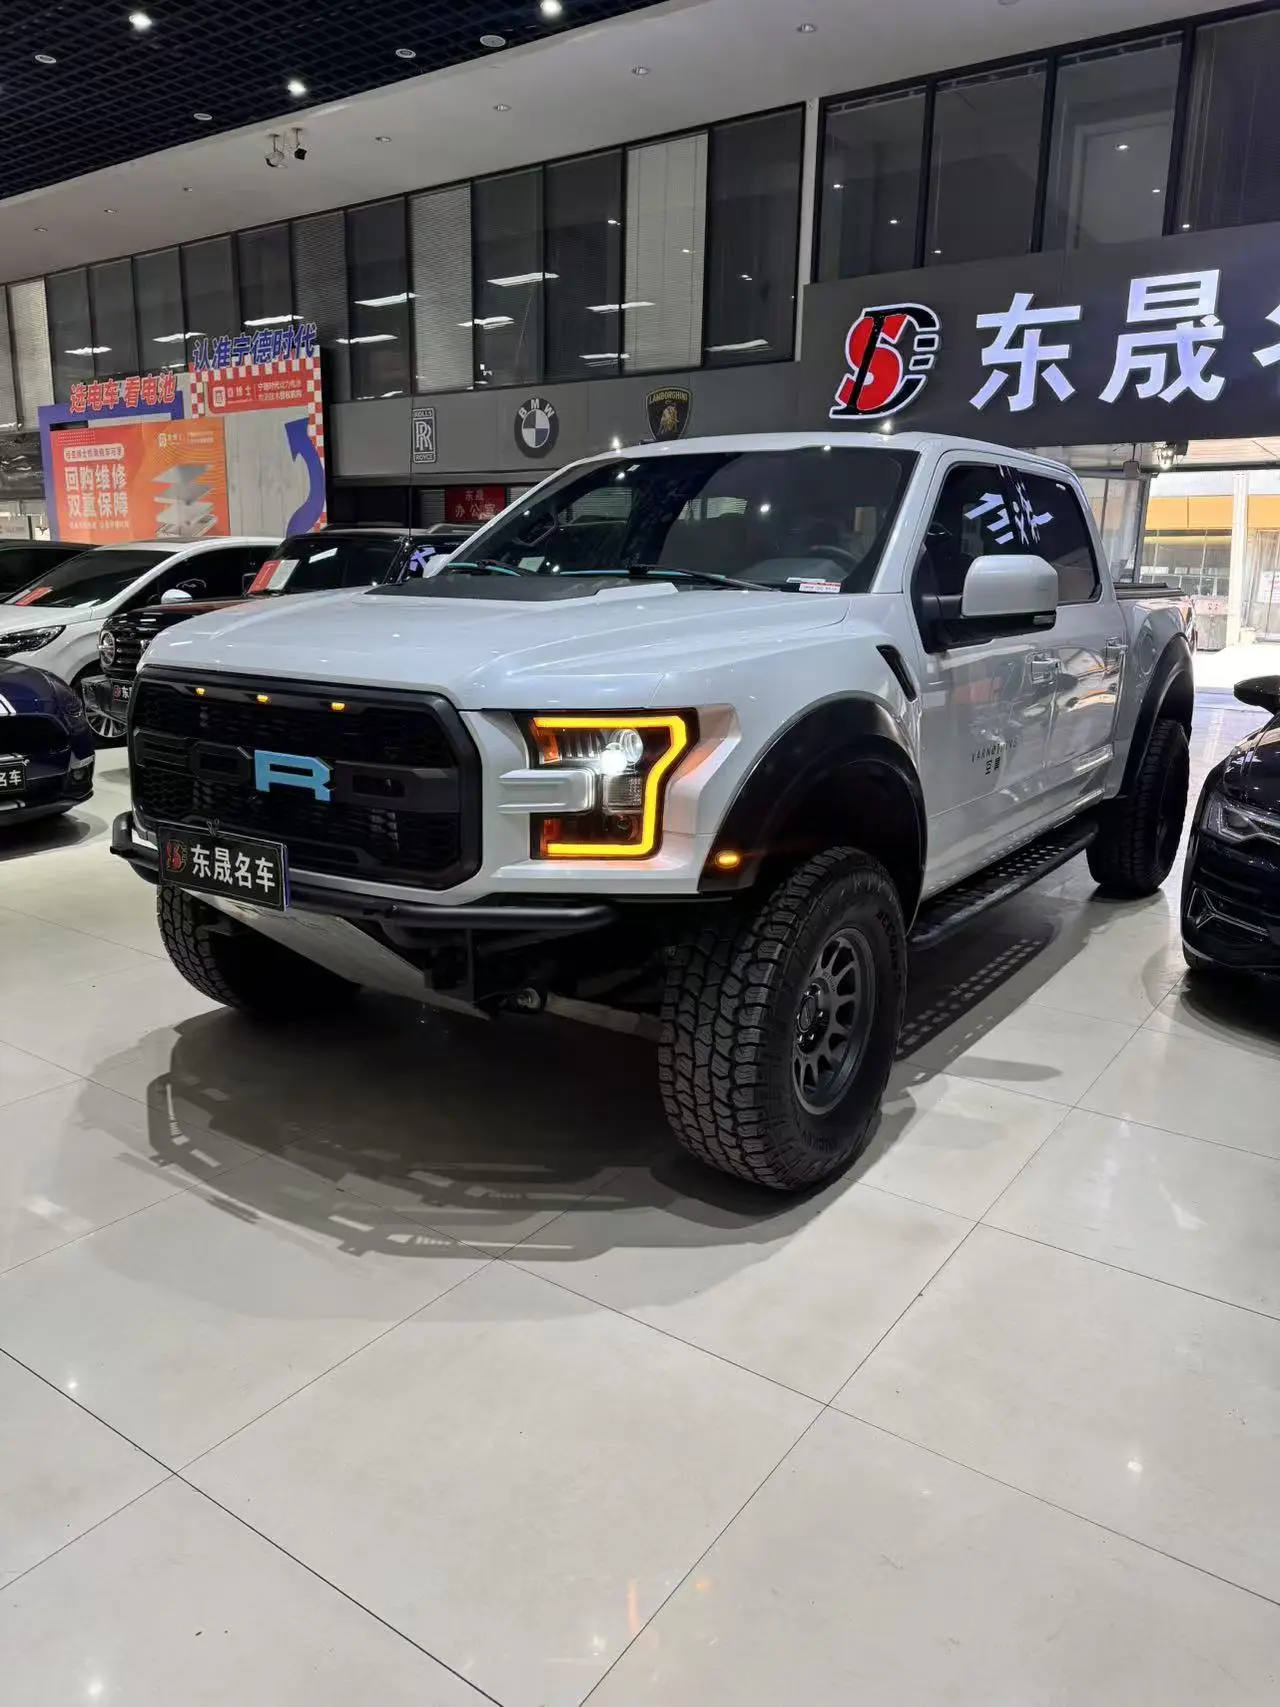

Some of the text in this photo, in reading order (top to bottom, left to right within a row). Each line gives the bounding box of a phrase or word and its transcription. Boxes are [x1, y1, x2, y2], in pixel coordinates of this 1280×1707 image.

[192, 323, 317, 370] 认准宁德时代
[970, 269, 1280, 412] 东晟
[70, 371, 177, 413] 选电车 看电池
[518, 398, 554, 419] BMW
[650, 391, 688, 403] LAMBORGHINI
[65, 464, 126, 493] 回购维修
[67, 491, 128, 518] 双重保障
[190, 844, 275, 893] 东晟名车
